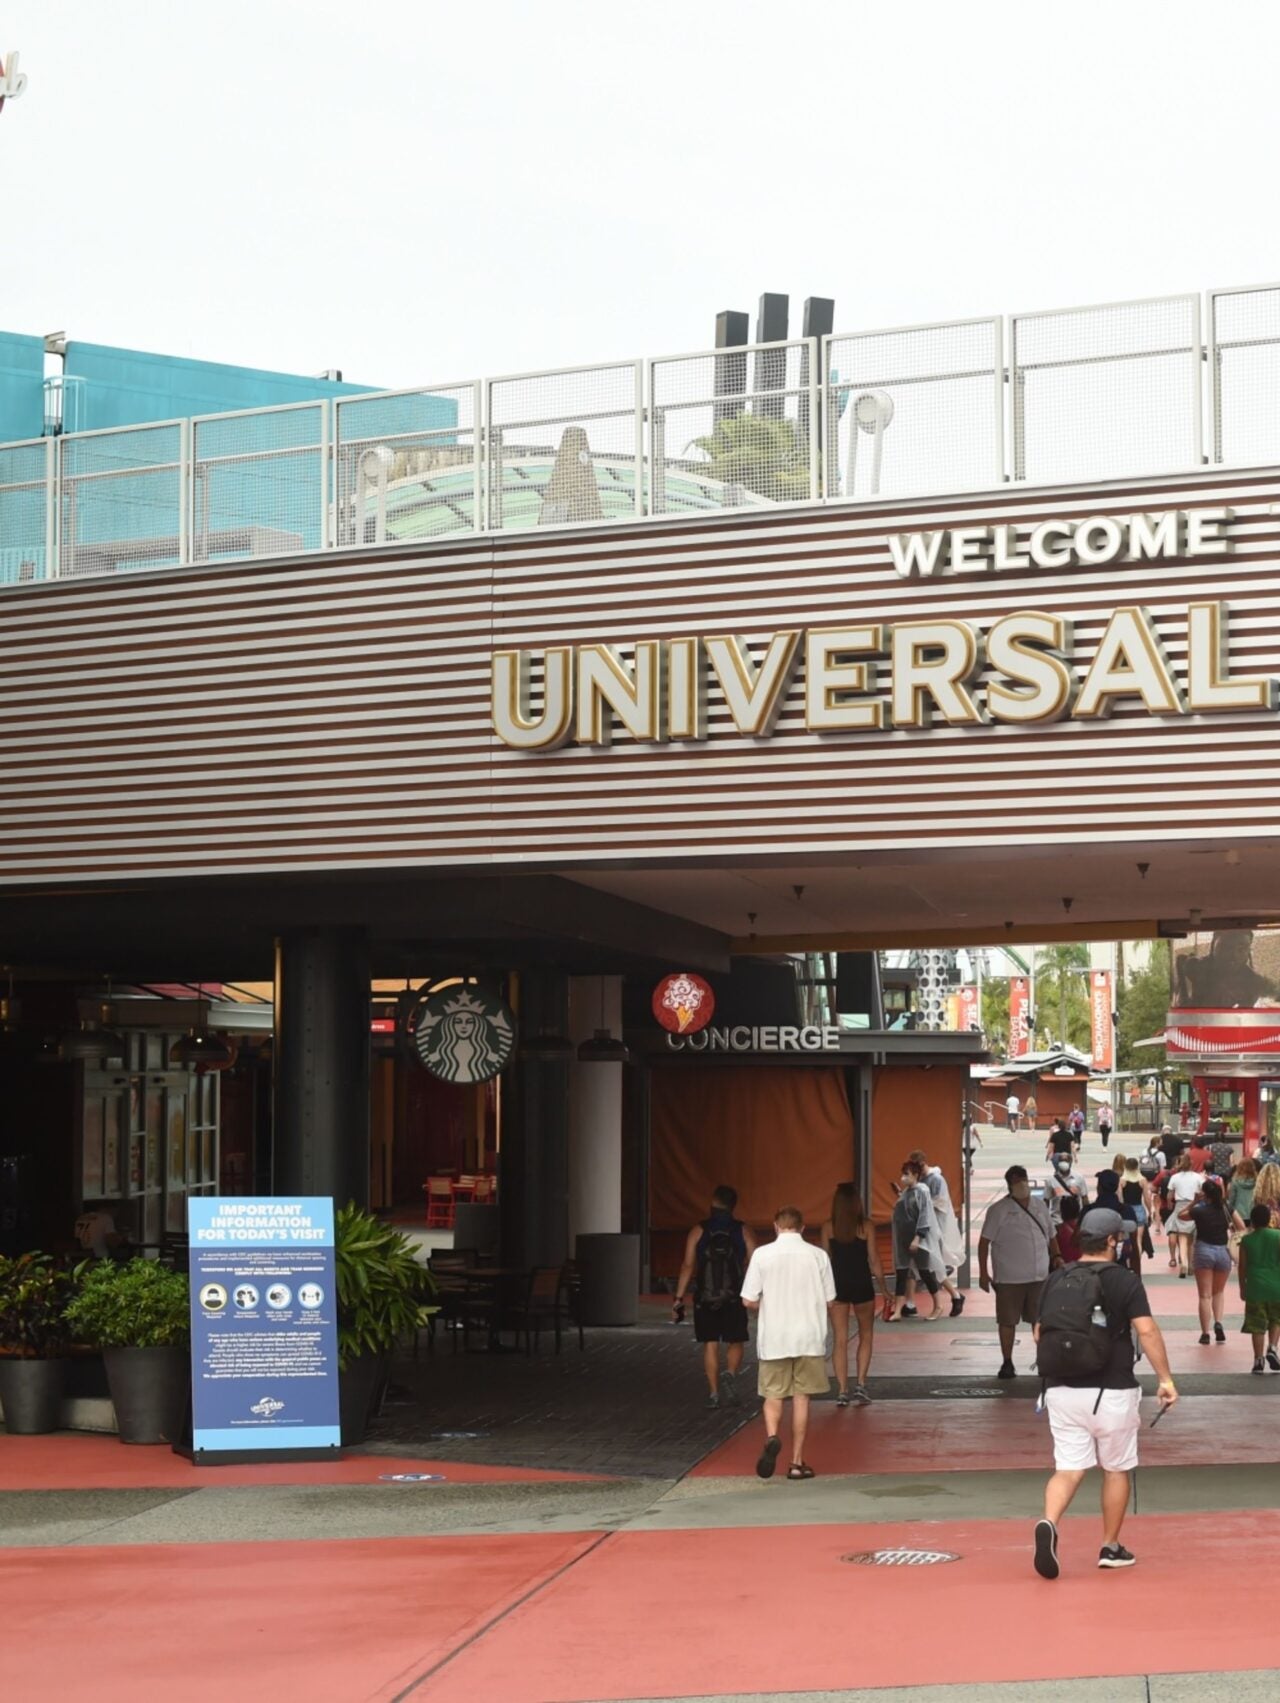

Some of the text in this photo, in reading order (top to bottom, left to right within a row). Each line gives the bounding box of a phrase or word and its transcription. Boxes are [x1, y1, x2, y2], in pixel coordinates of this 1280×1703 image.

[887, 507, 1234, 578] WELCOME
[491, 601, 1277, 752] UNIVERSAL
[667, 1025, 841, 1050] CONCIERGE
[219, 1205, 302, 1215] IMPORTANT
[211, 1217, 312, 1227] INFORMATION
[198, 1228, 325, 1240] FOR TODAY'S VISIT
